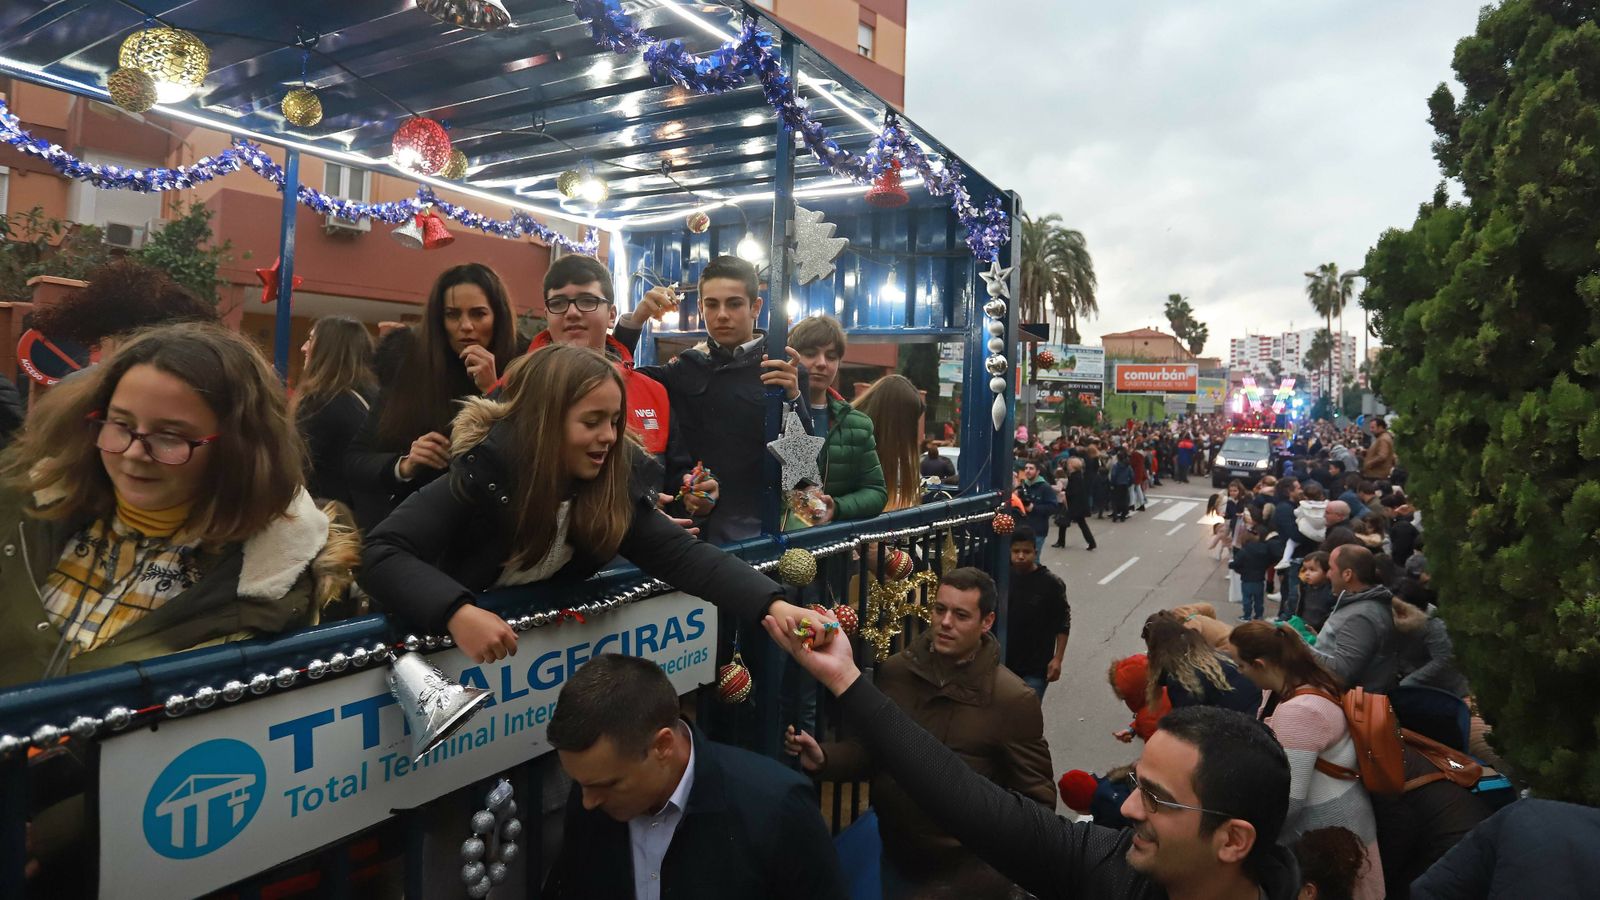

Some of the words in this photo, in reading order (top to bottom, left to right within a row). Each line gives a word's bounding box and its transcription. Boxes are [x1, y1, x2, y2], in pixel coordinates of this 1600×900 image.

[1124, 367, 1185, 380] comurbán
[635, 409, 657, 417] NASA
[458, 608, 706, 709] ALGECIRAS
[284, 761, 368, 817] Total
